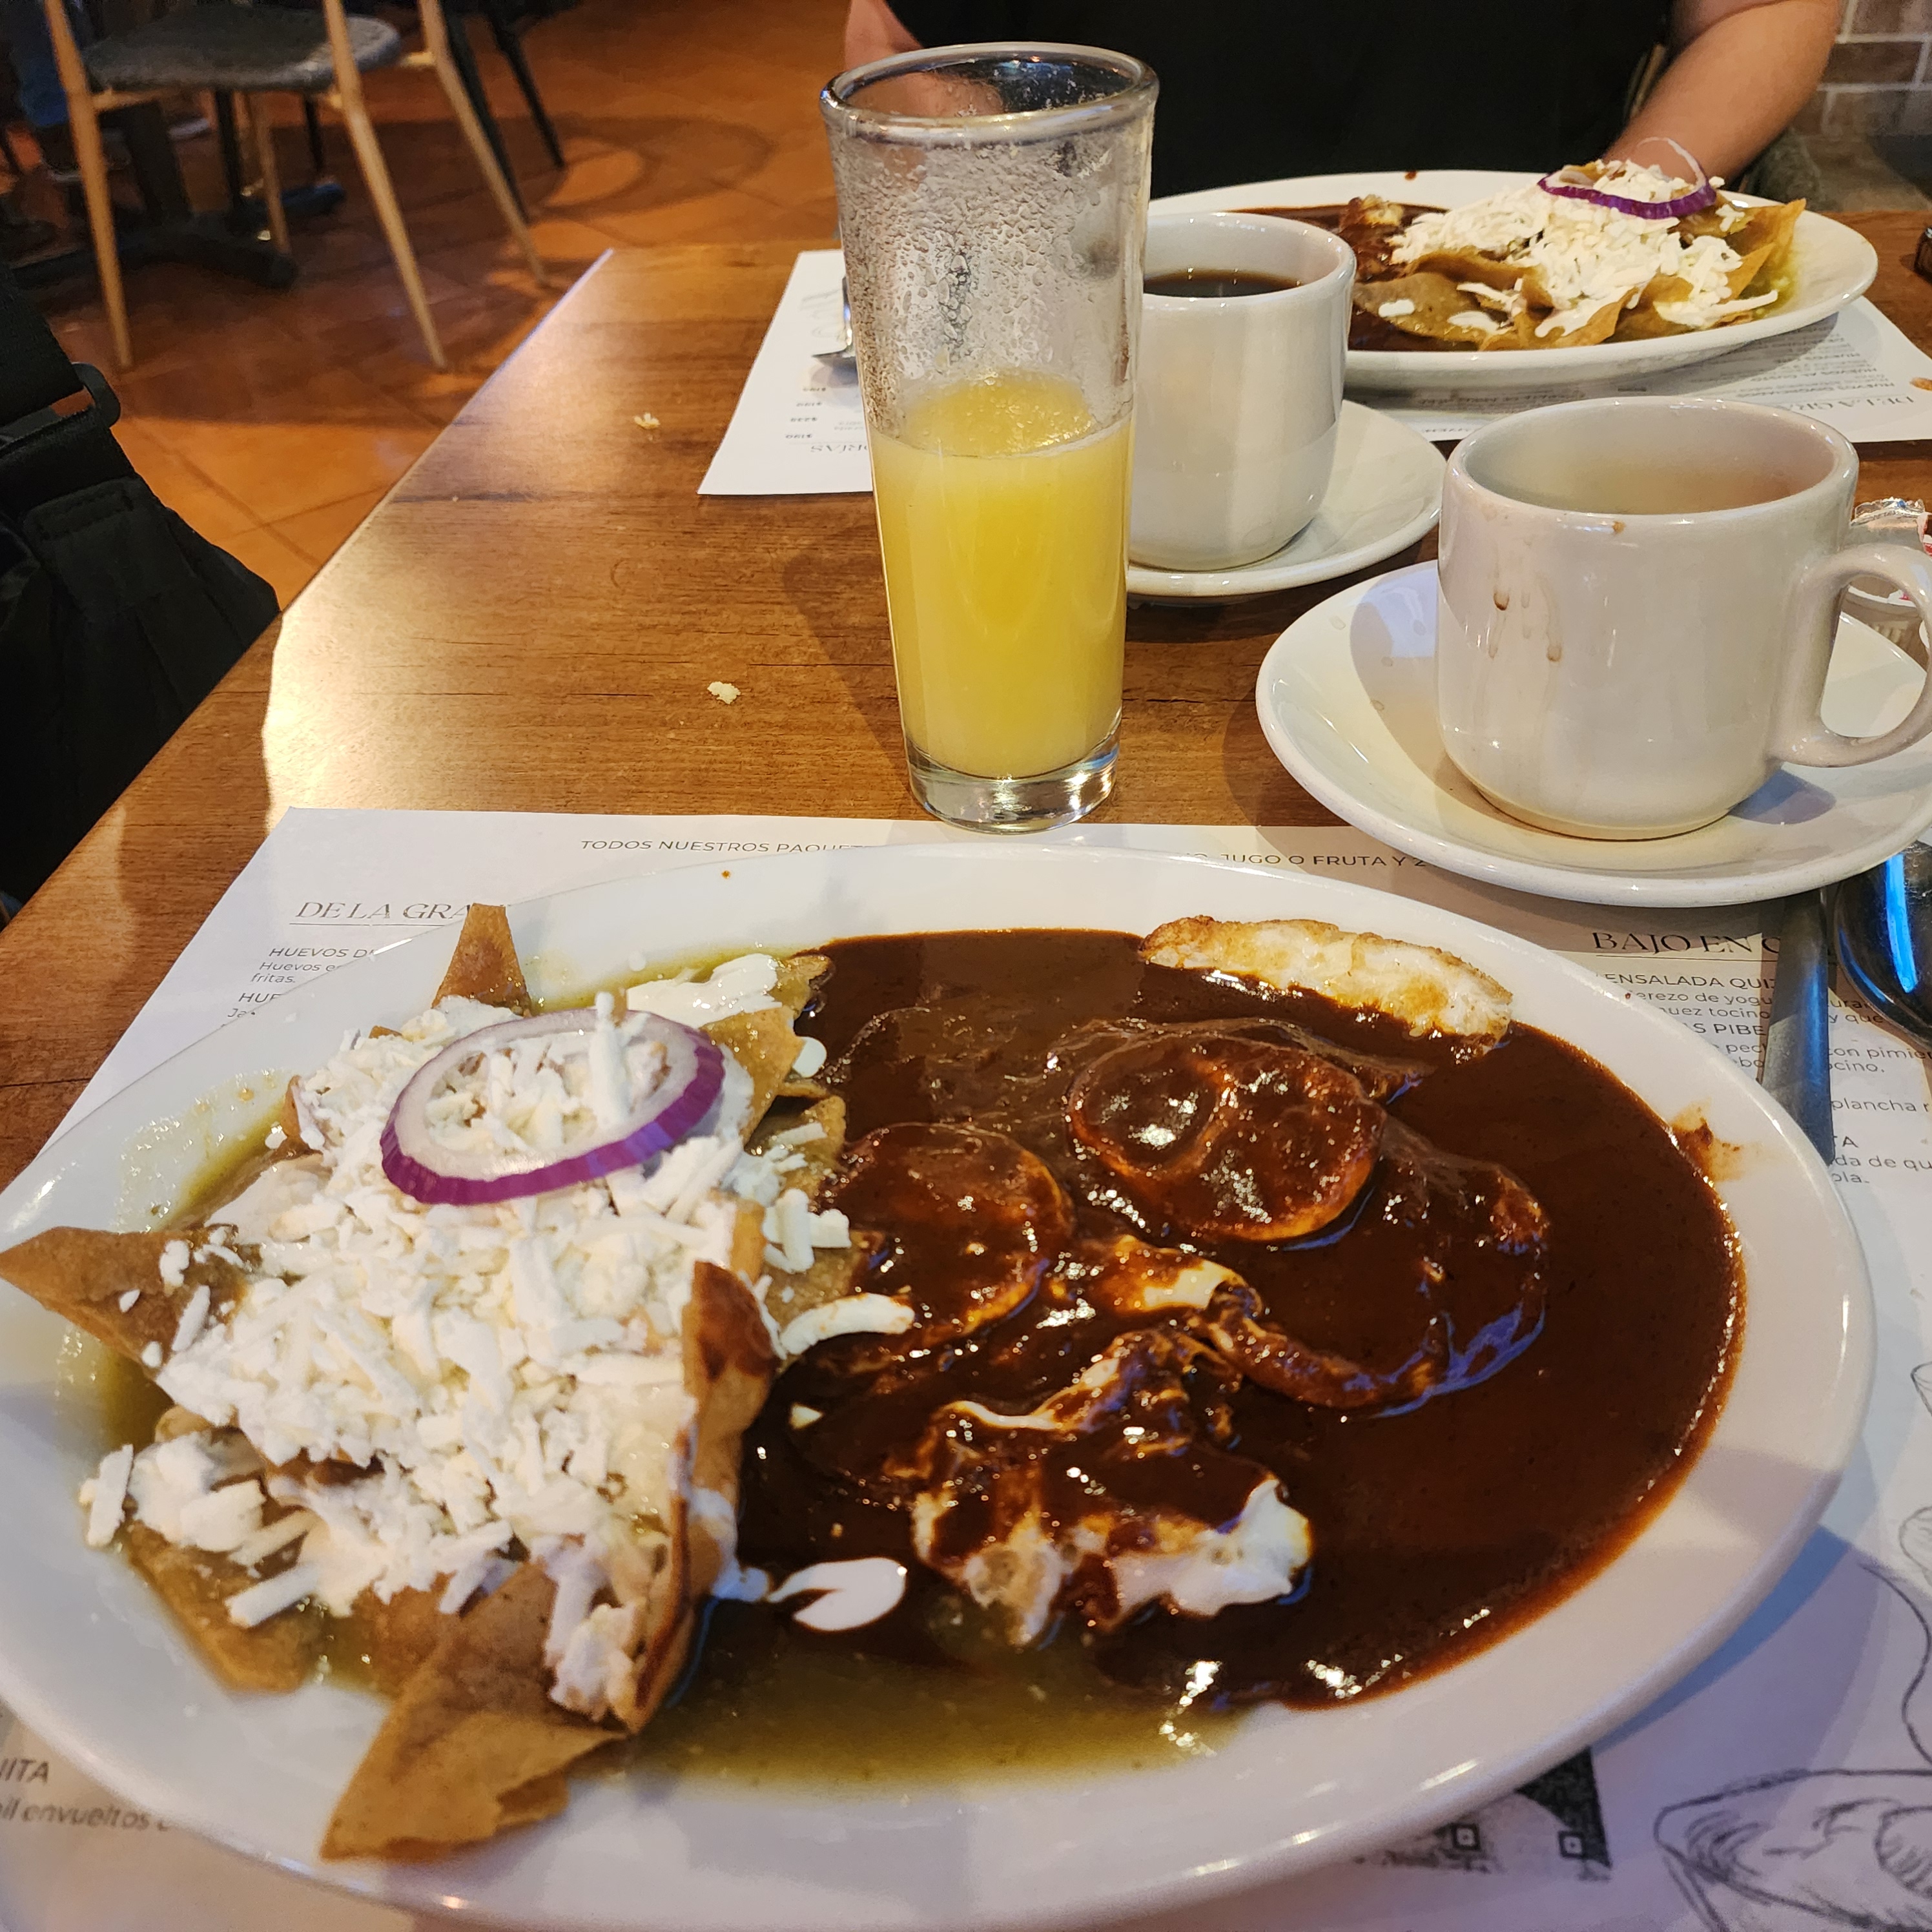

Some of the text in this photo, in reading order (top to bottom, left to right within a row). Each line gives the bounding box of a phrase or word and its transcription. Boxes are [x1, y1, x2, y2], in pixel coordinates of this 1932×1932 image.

[581, 840, 863, 853] TODOS NUESTROS PAQU
[1288, 855, 1304, 865] O
[1313, 855, 1388, 867] FRUTA
[1391, 856, 1407, 867] Y
[296, 901, 345, 918] DE
[346, 903, 391, 920] LA
[1592, 932, 1691, 954] BAJO
[1700, 934, 1753, 954] EN
[269, 948, 350, 958] HUEVOS
[259, 961, 322, 972] Huevos
[251, 972, 296, 984] fritas.
[1605, 973, 1725, 989] ENSALADA
[1695, 991, 1720, 1003] de
[1709, 1007, 1771, 1019] tocino
[1845, 1014, 1884, 1025] que
[1868, 1155, 1896, 1168] de
